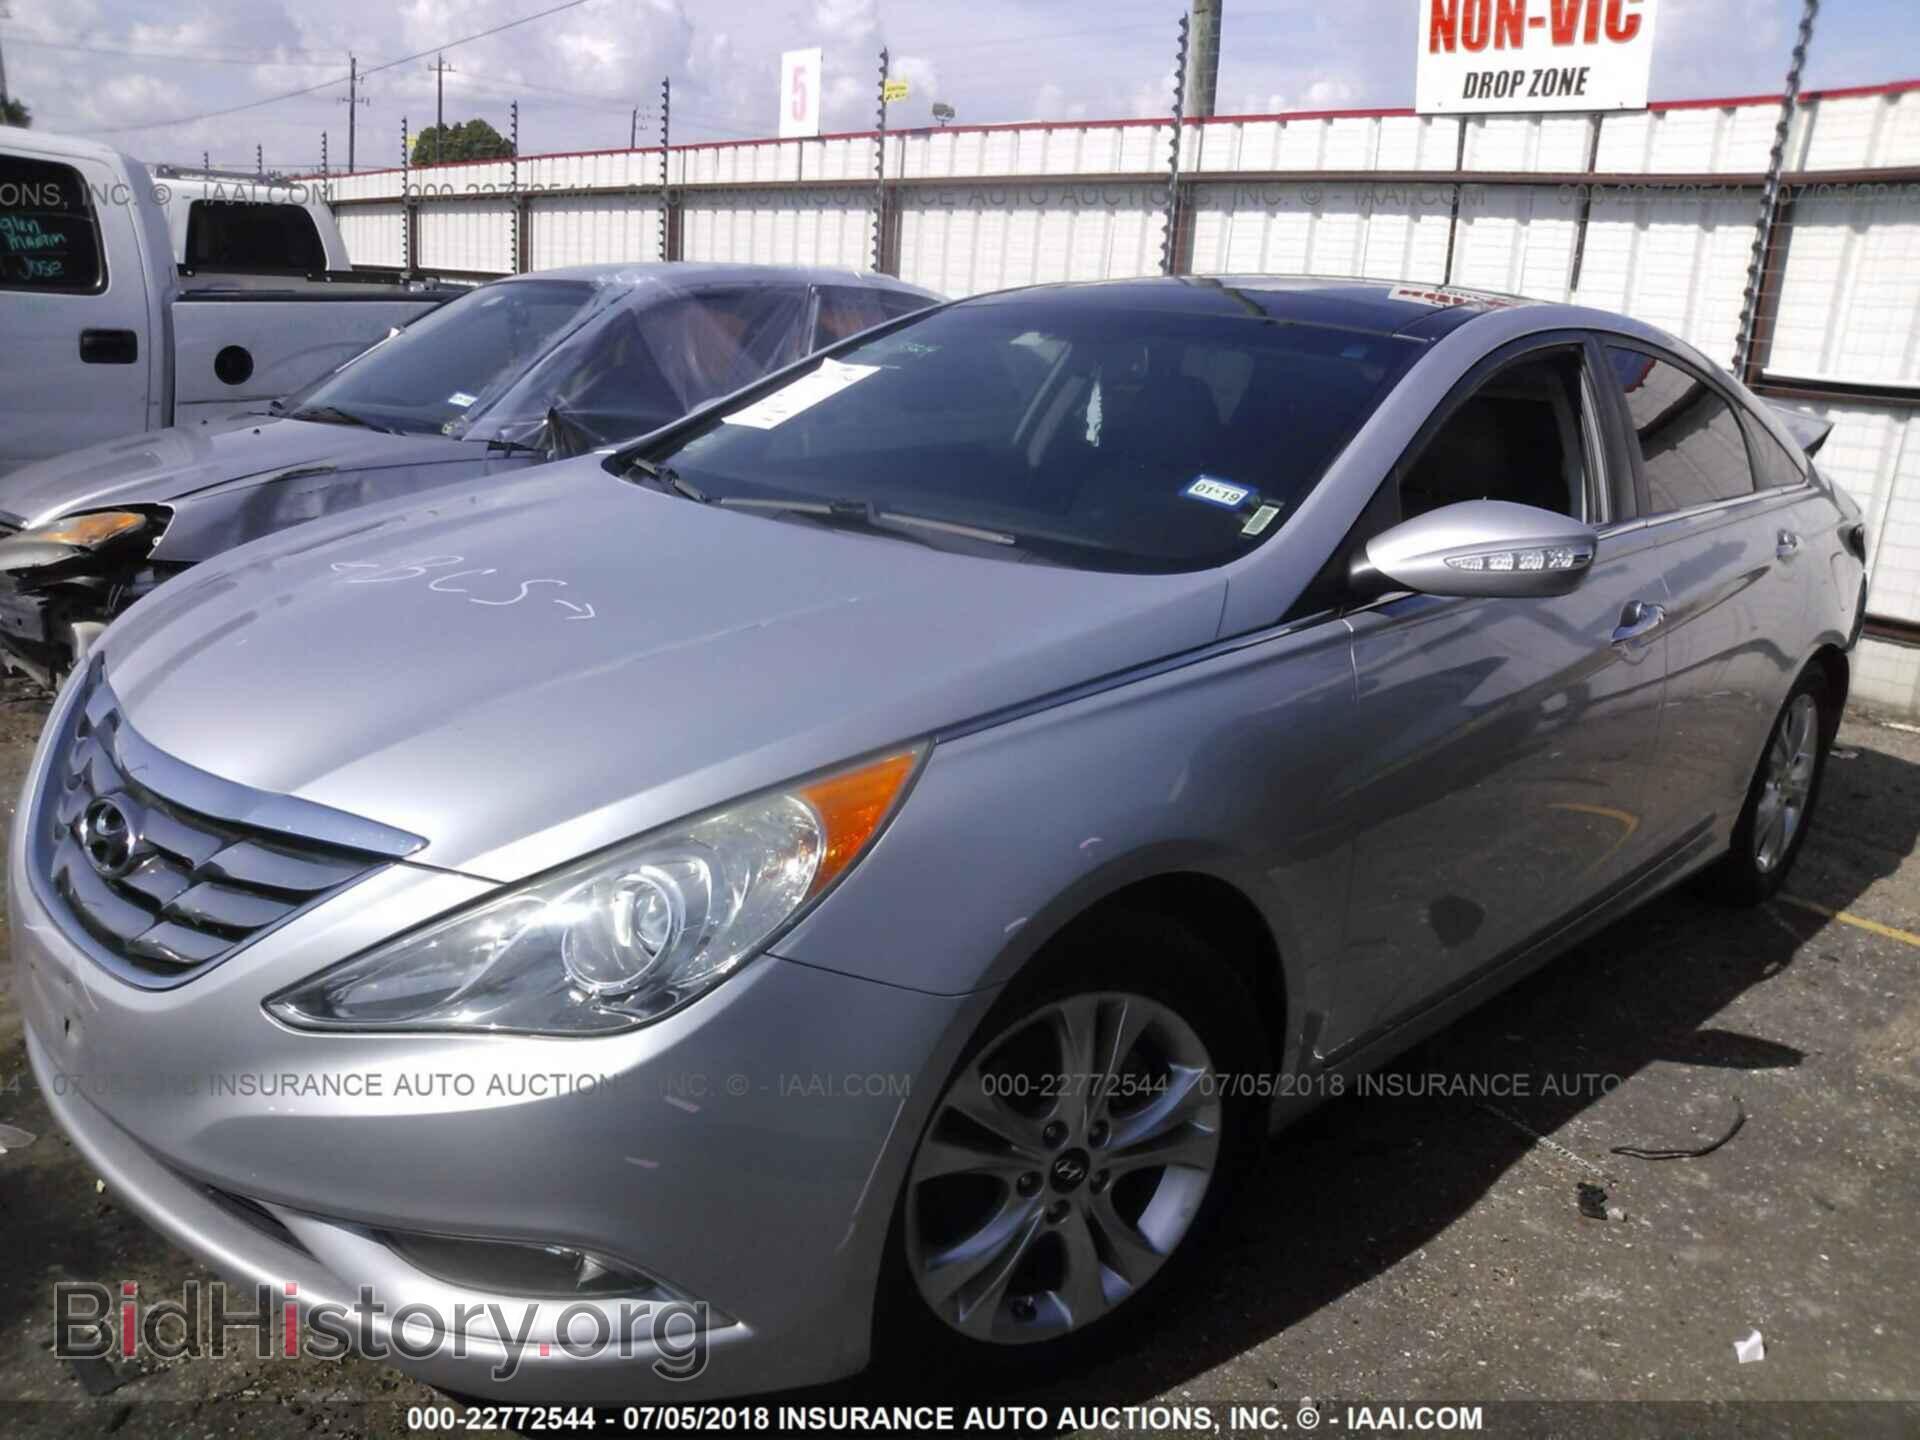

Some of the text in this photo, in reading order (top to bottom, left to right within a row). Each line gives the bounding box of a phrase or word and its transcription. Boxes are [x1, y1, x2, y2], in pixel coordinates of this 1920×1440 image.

[1429, 0, 1641, 54] NON-VIC
[792, 65, 808, 122] 5
[1463, 66, 1590, 99] DROP ZONE
